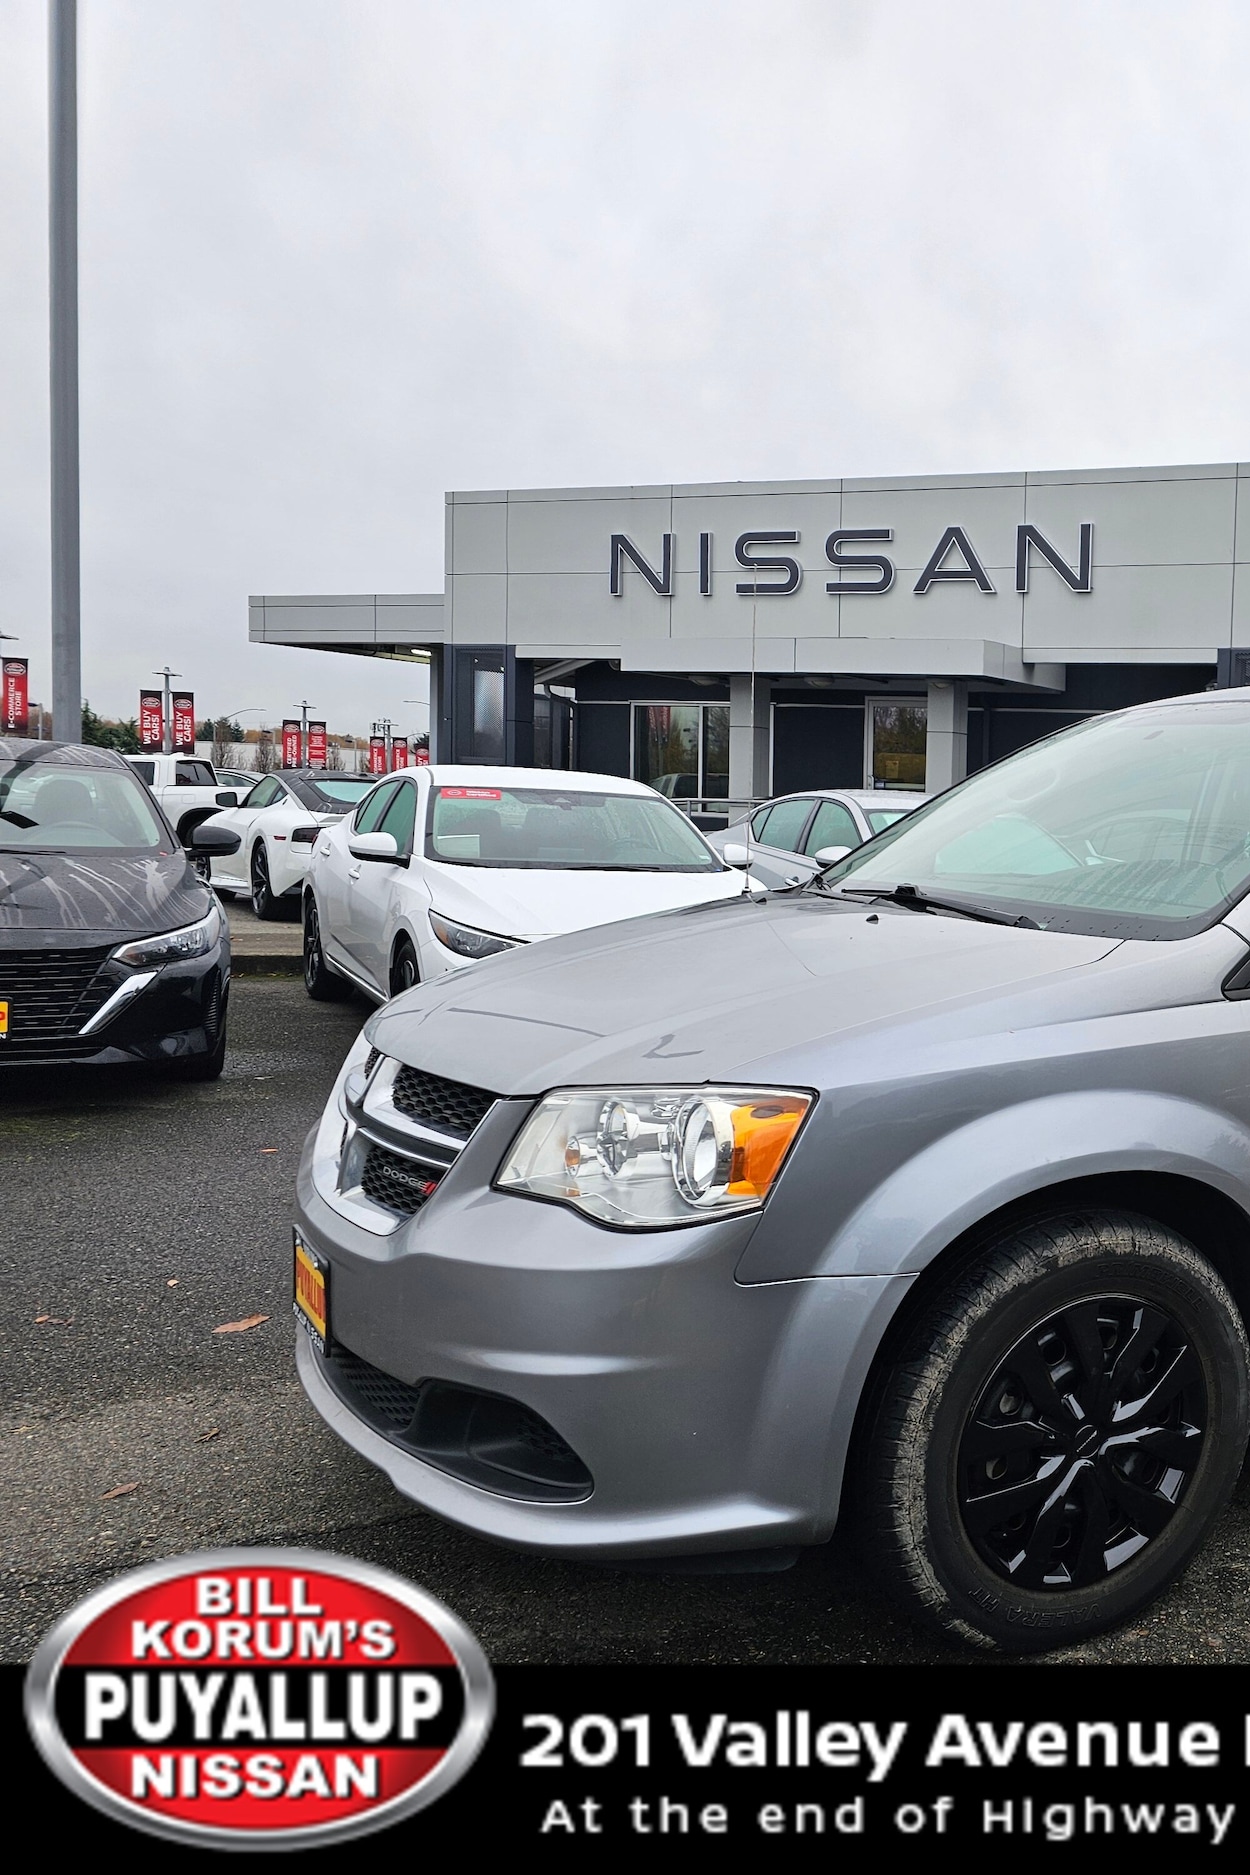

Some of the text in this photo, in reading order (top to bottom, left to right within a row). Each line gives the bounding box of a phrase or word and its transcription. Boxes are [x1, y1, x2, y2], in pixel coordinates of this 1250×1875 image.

[609, 522, 1094, 597] NISSAN
[143, 710, 151, 729] BUY
[152, 714, 160, 741] CARS!
[143, 730, 151, 745] WE
[176, 731, 183, 746] WE
[382, 1166, 428, 1192] DODGE
[1096, 1261, 1204, 1312] PRIMEWELL
[968, 1586, 1103, 1629] VALERA HT
